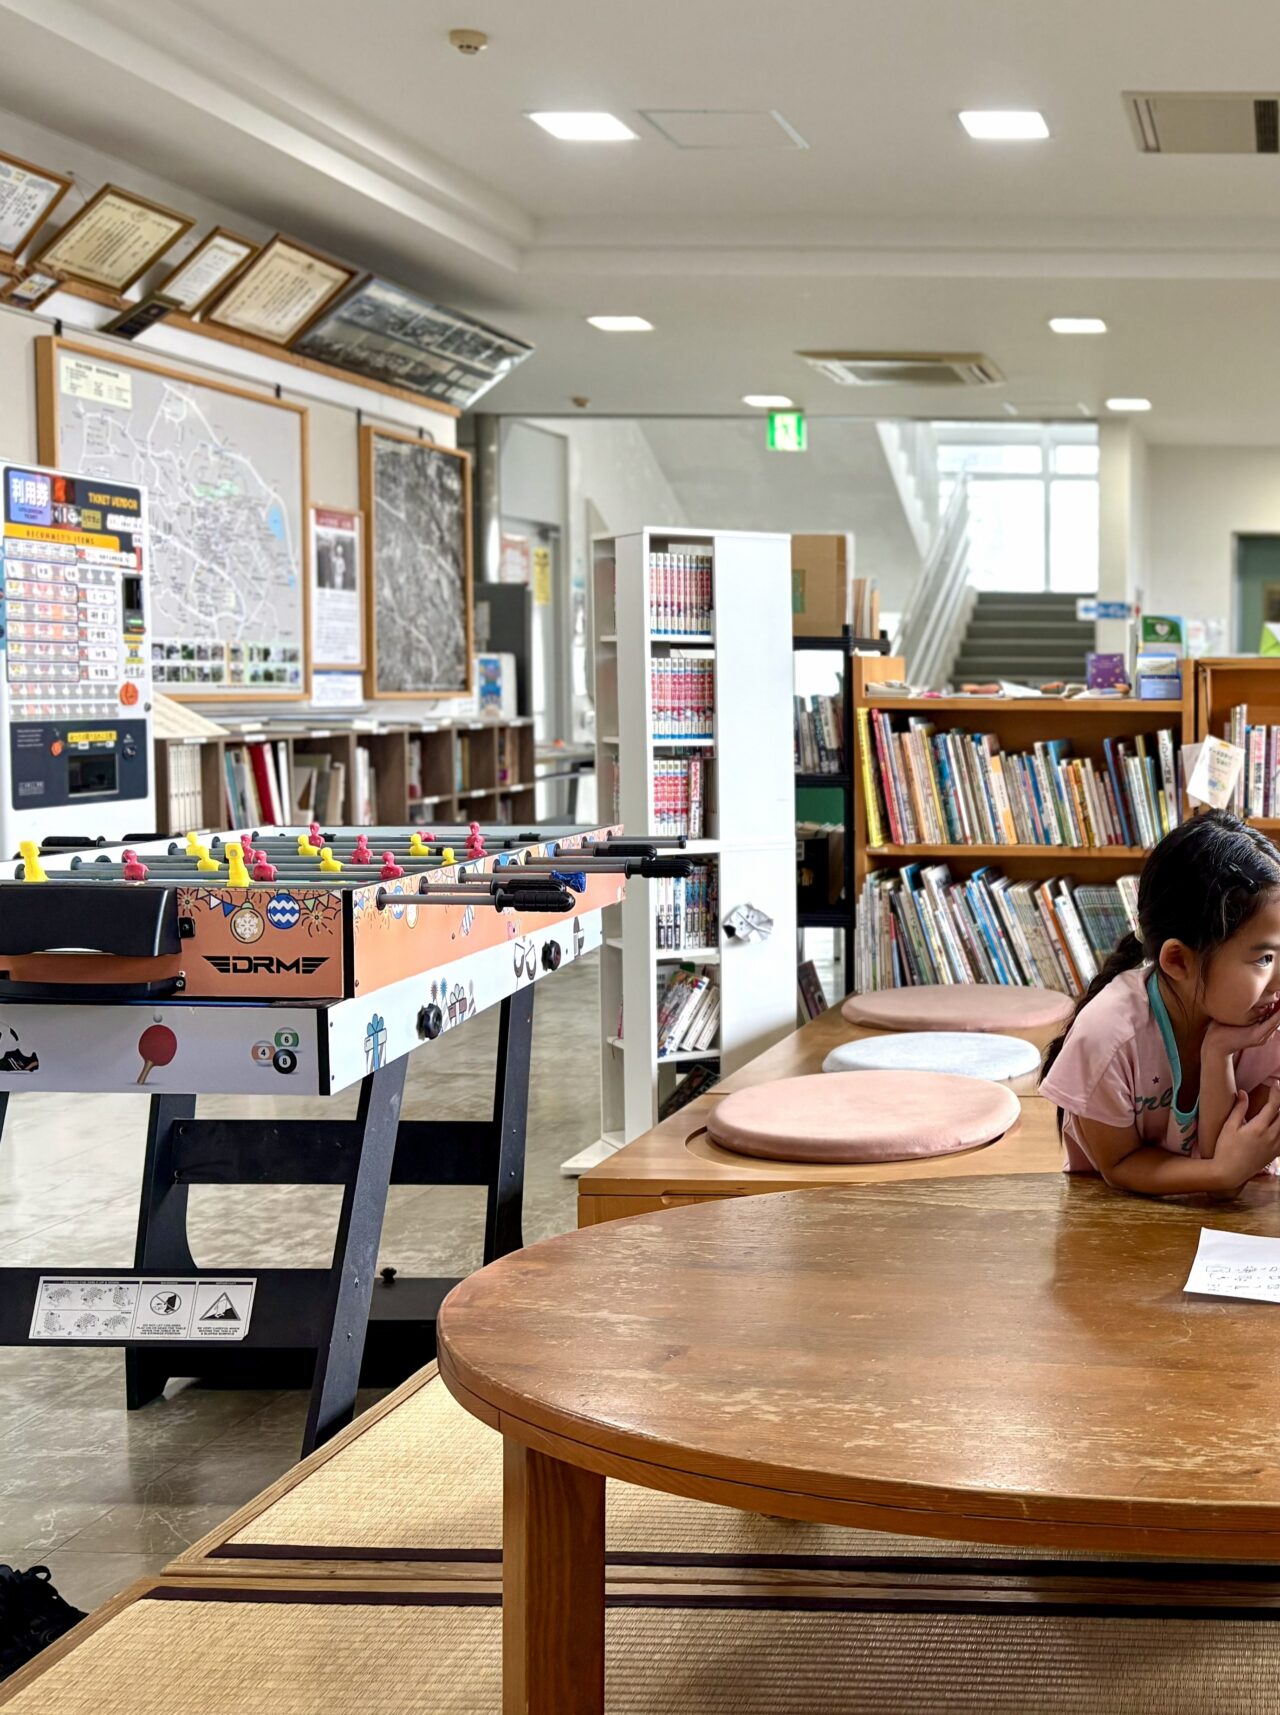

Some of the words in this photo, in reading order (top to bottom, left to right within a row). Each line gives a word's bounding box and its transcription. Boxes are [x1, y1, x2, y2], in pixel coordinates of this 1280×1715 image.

[12, 478, 50, 507] 利用券
[88, 492, 111, 506] TICKET
[111, 495, 138, 510] VENDOR
